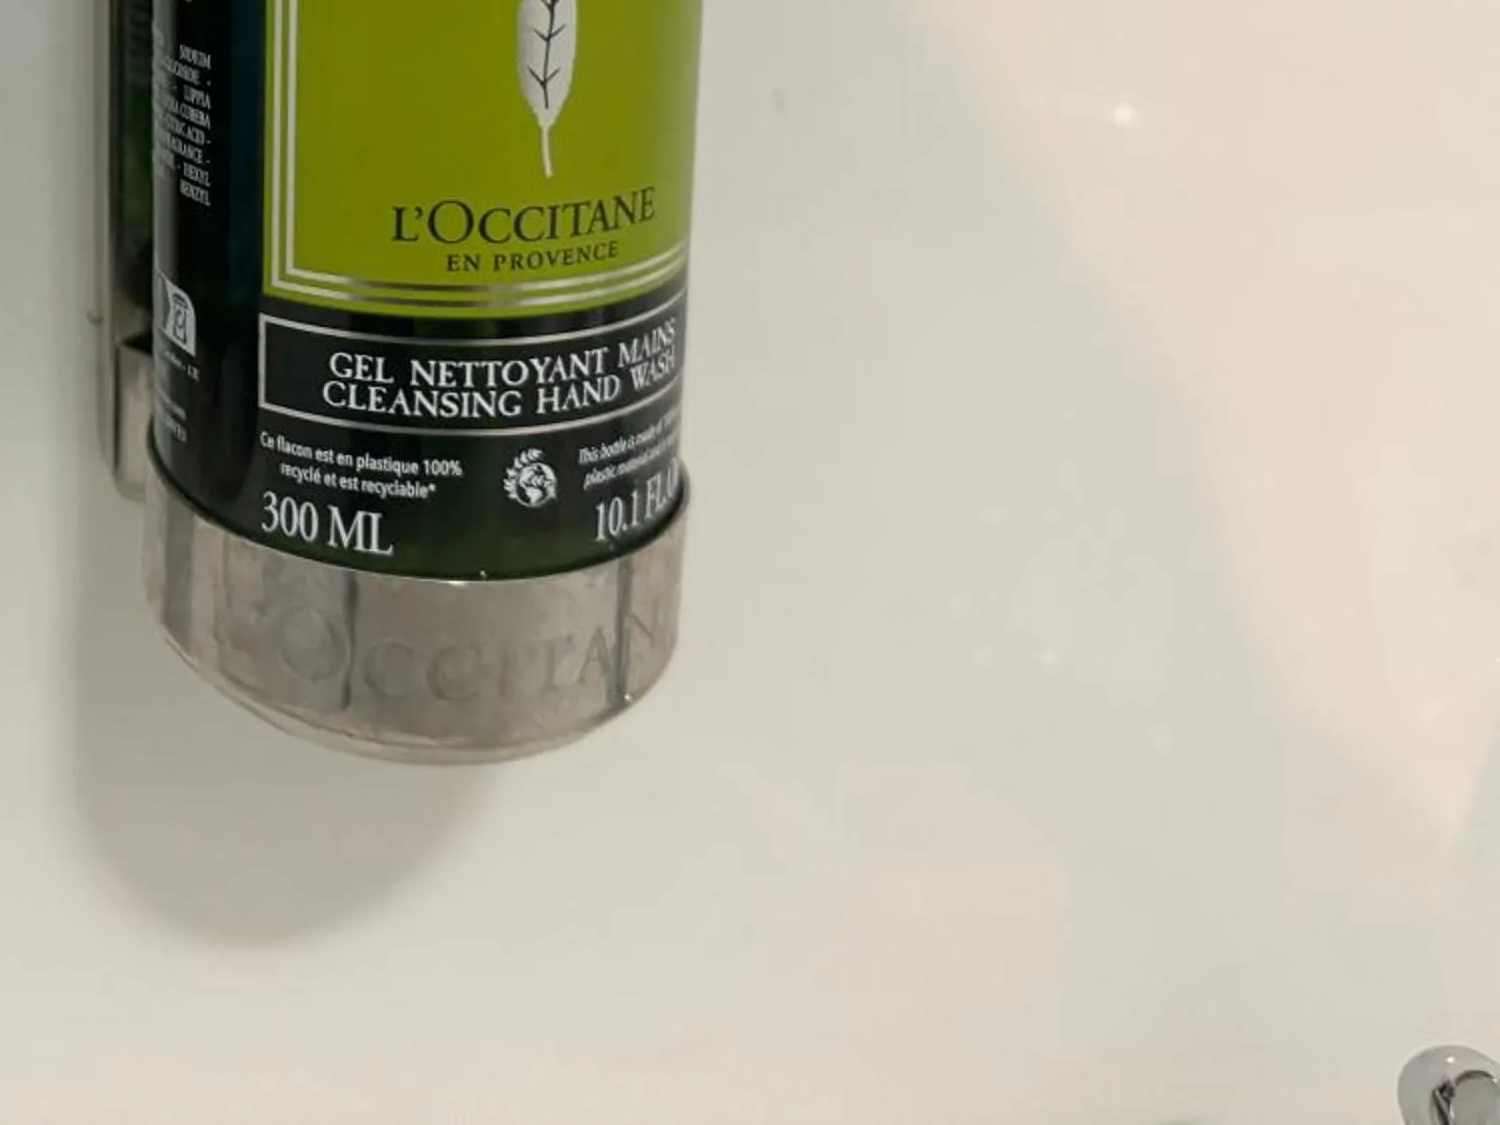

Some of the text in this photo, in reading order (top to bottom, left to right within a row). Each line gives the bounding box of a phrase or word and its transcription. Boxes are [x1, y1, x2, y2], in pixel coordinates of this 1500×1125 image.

[391, 186, 657, 244] L'OCCITANE
[446, 240, 619, 273] EN PROVENCE
[329, 317, 675, 389] GEL NETTOYANT MAINS
[322, 380, 522, 418] CLEANSING
[535, 374, 621, 415] HAND
[260, 431, 464, 477] Ce flacon est en plastique 100%
[323, 472, 337, 487] et
[339, 476, 359, 492] est
[261, 490, 395, 556] 300 ML
[595, 489, 640, 542] 10.1
